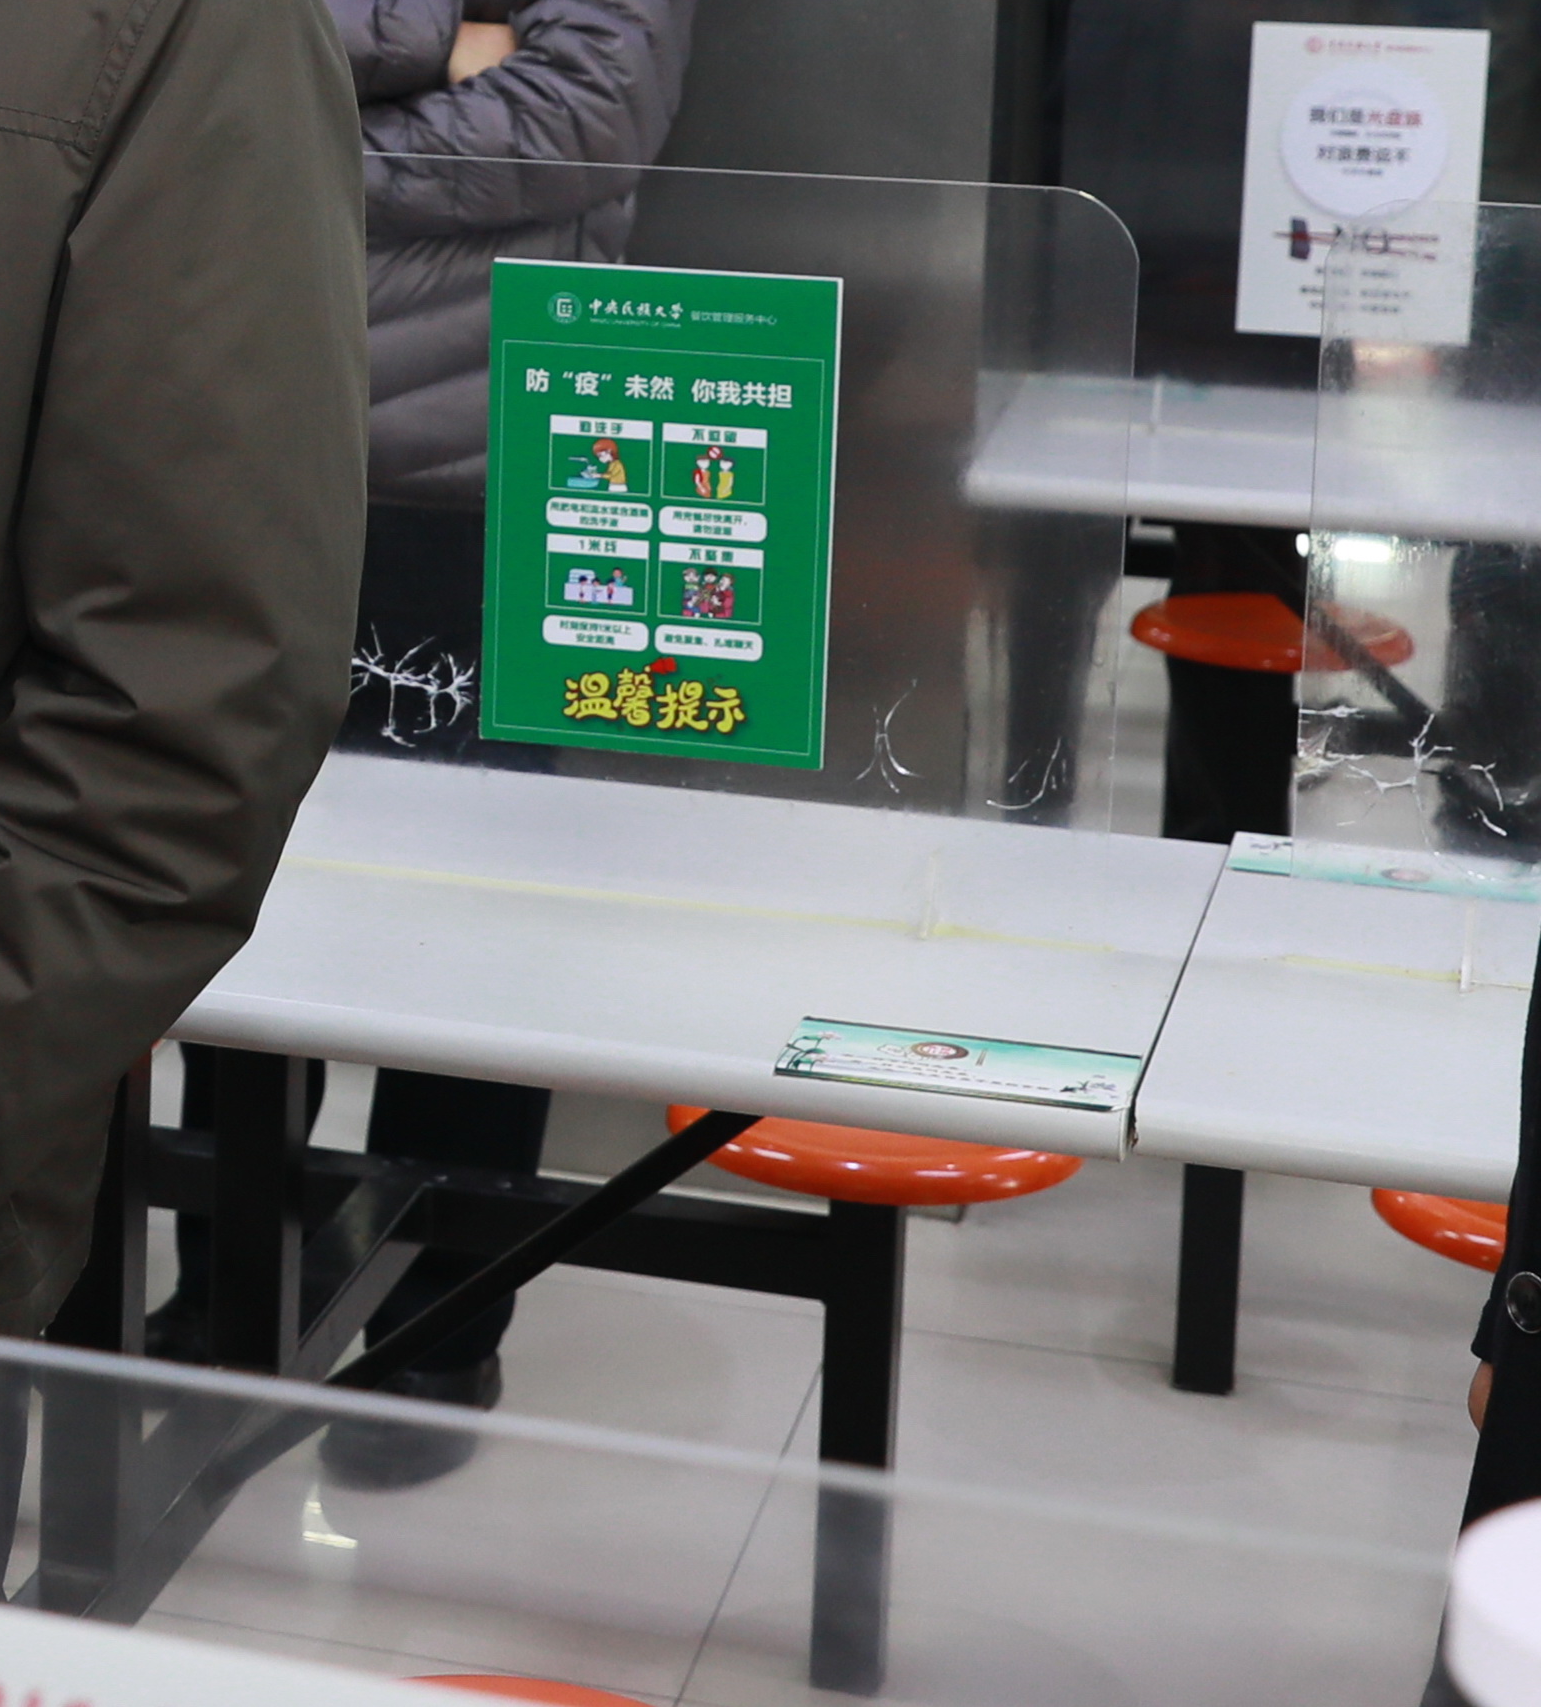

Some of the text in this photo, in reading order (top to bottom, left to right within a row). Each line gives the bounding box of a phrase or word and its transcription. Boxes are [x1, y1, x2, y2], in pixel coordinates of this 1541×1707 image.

[588, 298, 778, 326] 中央民族大学 餐饮管理服务中心
[525, 368, 793, 408] 防 “疫” 未然 你我共担
[579, 420, 624, 435] 勤洗手
[563, 669, 746, 733] 温馨提示
